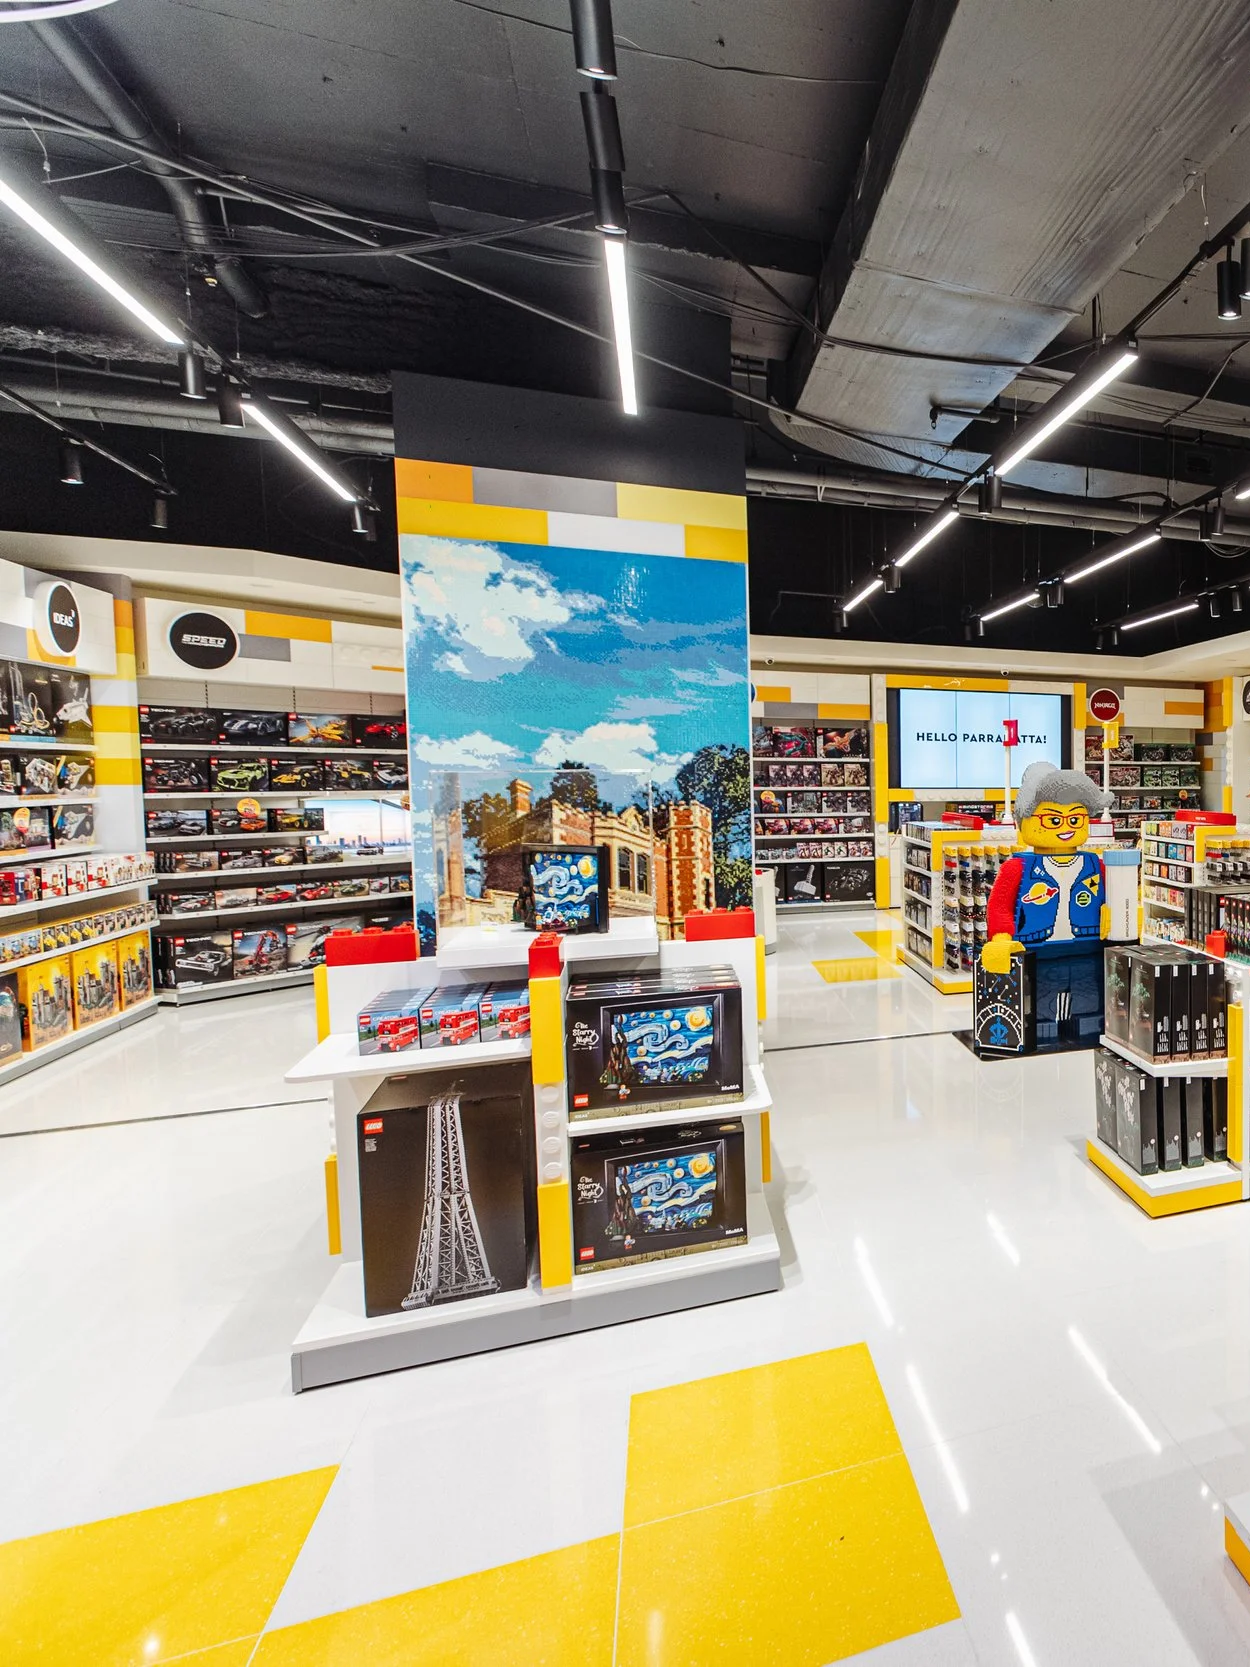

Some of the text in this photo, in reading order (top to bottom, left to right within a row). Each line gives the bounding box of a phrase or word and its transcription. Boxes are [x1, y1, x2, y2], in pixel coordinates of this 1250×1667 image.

[53, 612, 73, 628] IDEAS
[181, 634, 227, 645] SPEED
[916, 732, 1047, 744] HELLO PARRAATTA!
[577, 1182, 600, 1190] Starry
